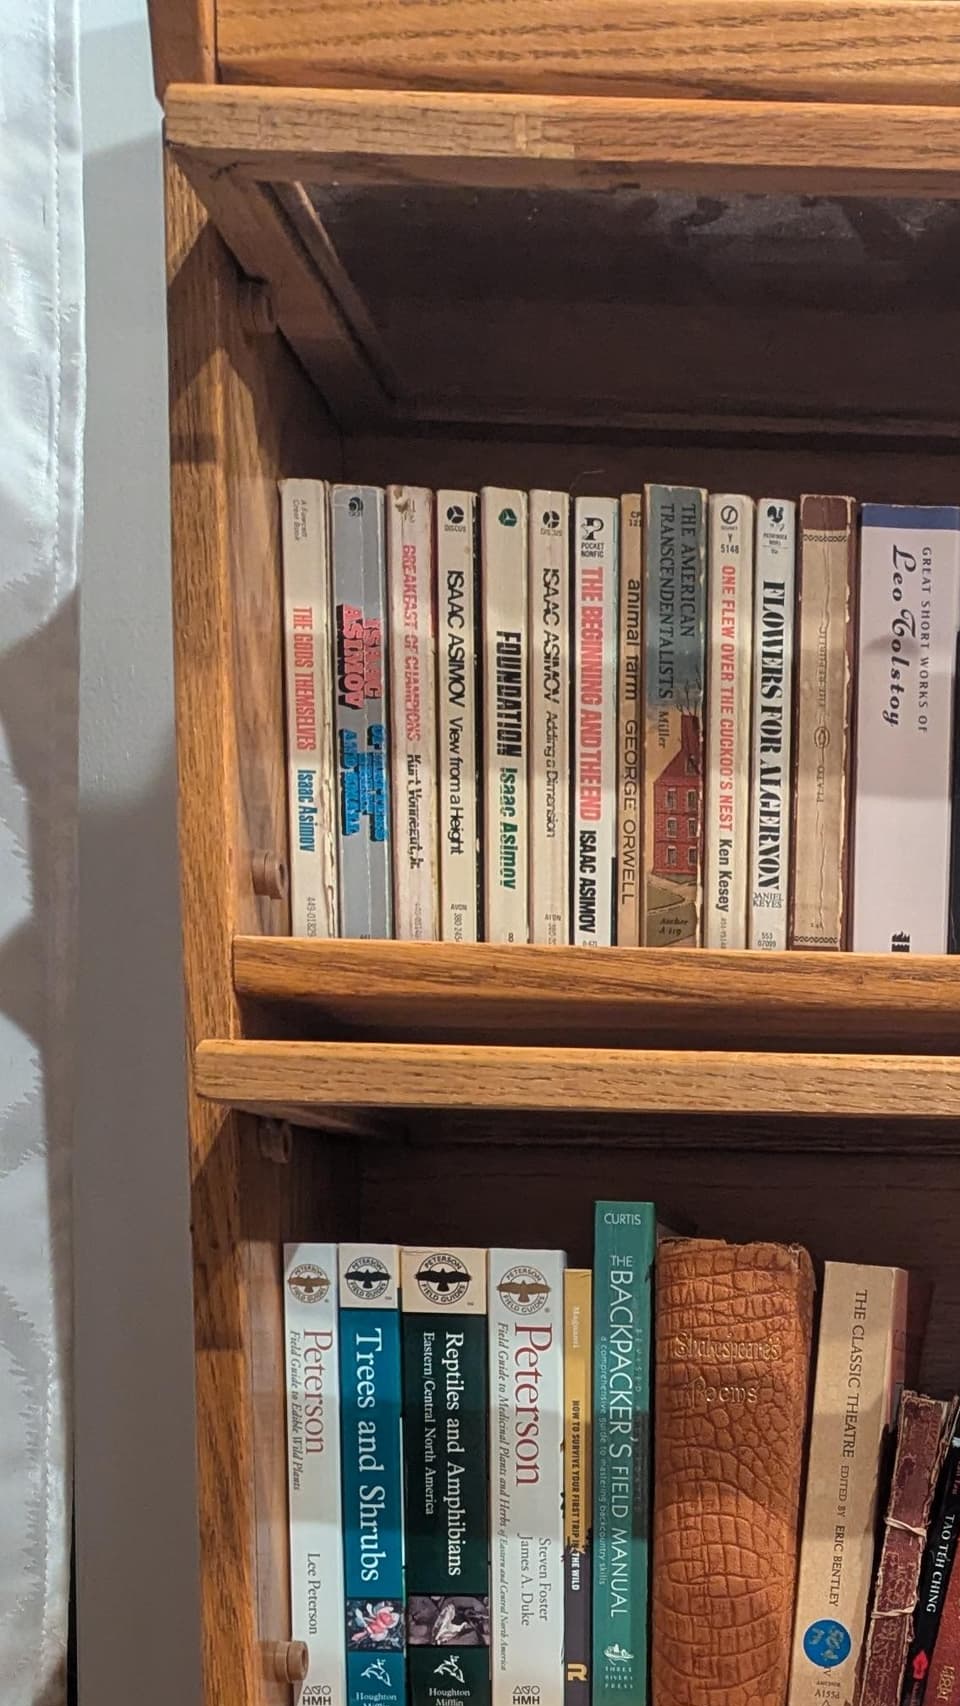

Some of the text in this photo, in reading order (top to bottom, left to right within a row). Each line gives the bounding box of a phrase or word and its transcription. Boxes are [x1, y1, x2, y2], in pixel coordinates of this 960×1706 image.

[658, 503, 676, 700] TRANSCENDENTALISTS
[680, 503, 697, 639] THE AMERICAN
[719, 544, 740, 554] 5148
[496, 630, 523, 758] FOUNDATION
[717, 565, 736, 833] ONE FLEW OVER THE CUCKOO'S NEST
[881, 545, 917, 727] Leo Tolstoy
[917, 546, 934, 733] GREAT SHORT WORKS OF
[620, 578, 642, 906] animal farm GEORGE ORWELL
[657, 711, 669, 749] Miller
[756, 580, 785, 891] FLOWERS FOR ALGERNON
[498, 767, 519, 890] Isaac Asimov
[715, 838, 732, 913] Ken Kesey
[752, 892, 782, 901] DANIEL
[752, 900, 782, 909] KEYES
[604, 1212, 642, 1226] CURTIS
[303, 1328, 335, 1455] Peterson
[355, 1327, 383, 1583] Trees and Shrubs
[444, 1331, 466, 1577] Reptiles and Amphibians
[514, 1322, 553, 1487] Peterson
[610, 1255, 635, 1617] THE BACKPACKER'S FIELD MANUAL
[827, 1289, 868, 1608] THE CLASSIC THEATRE EDITED BY ERIC BENTLEY
[302, 1695, 331, 1706] HMH
[511, 1694, 541, 1705] HMH
